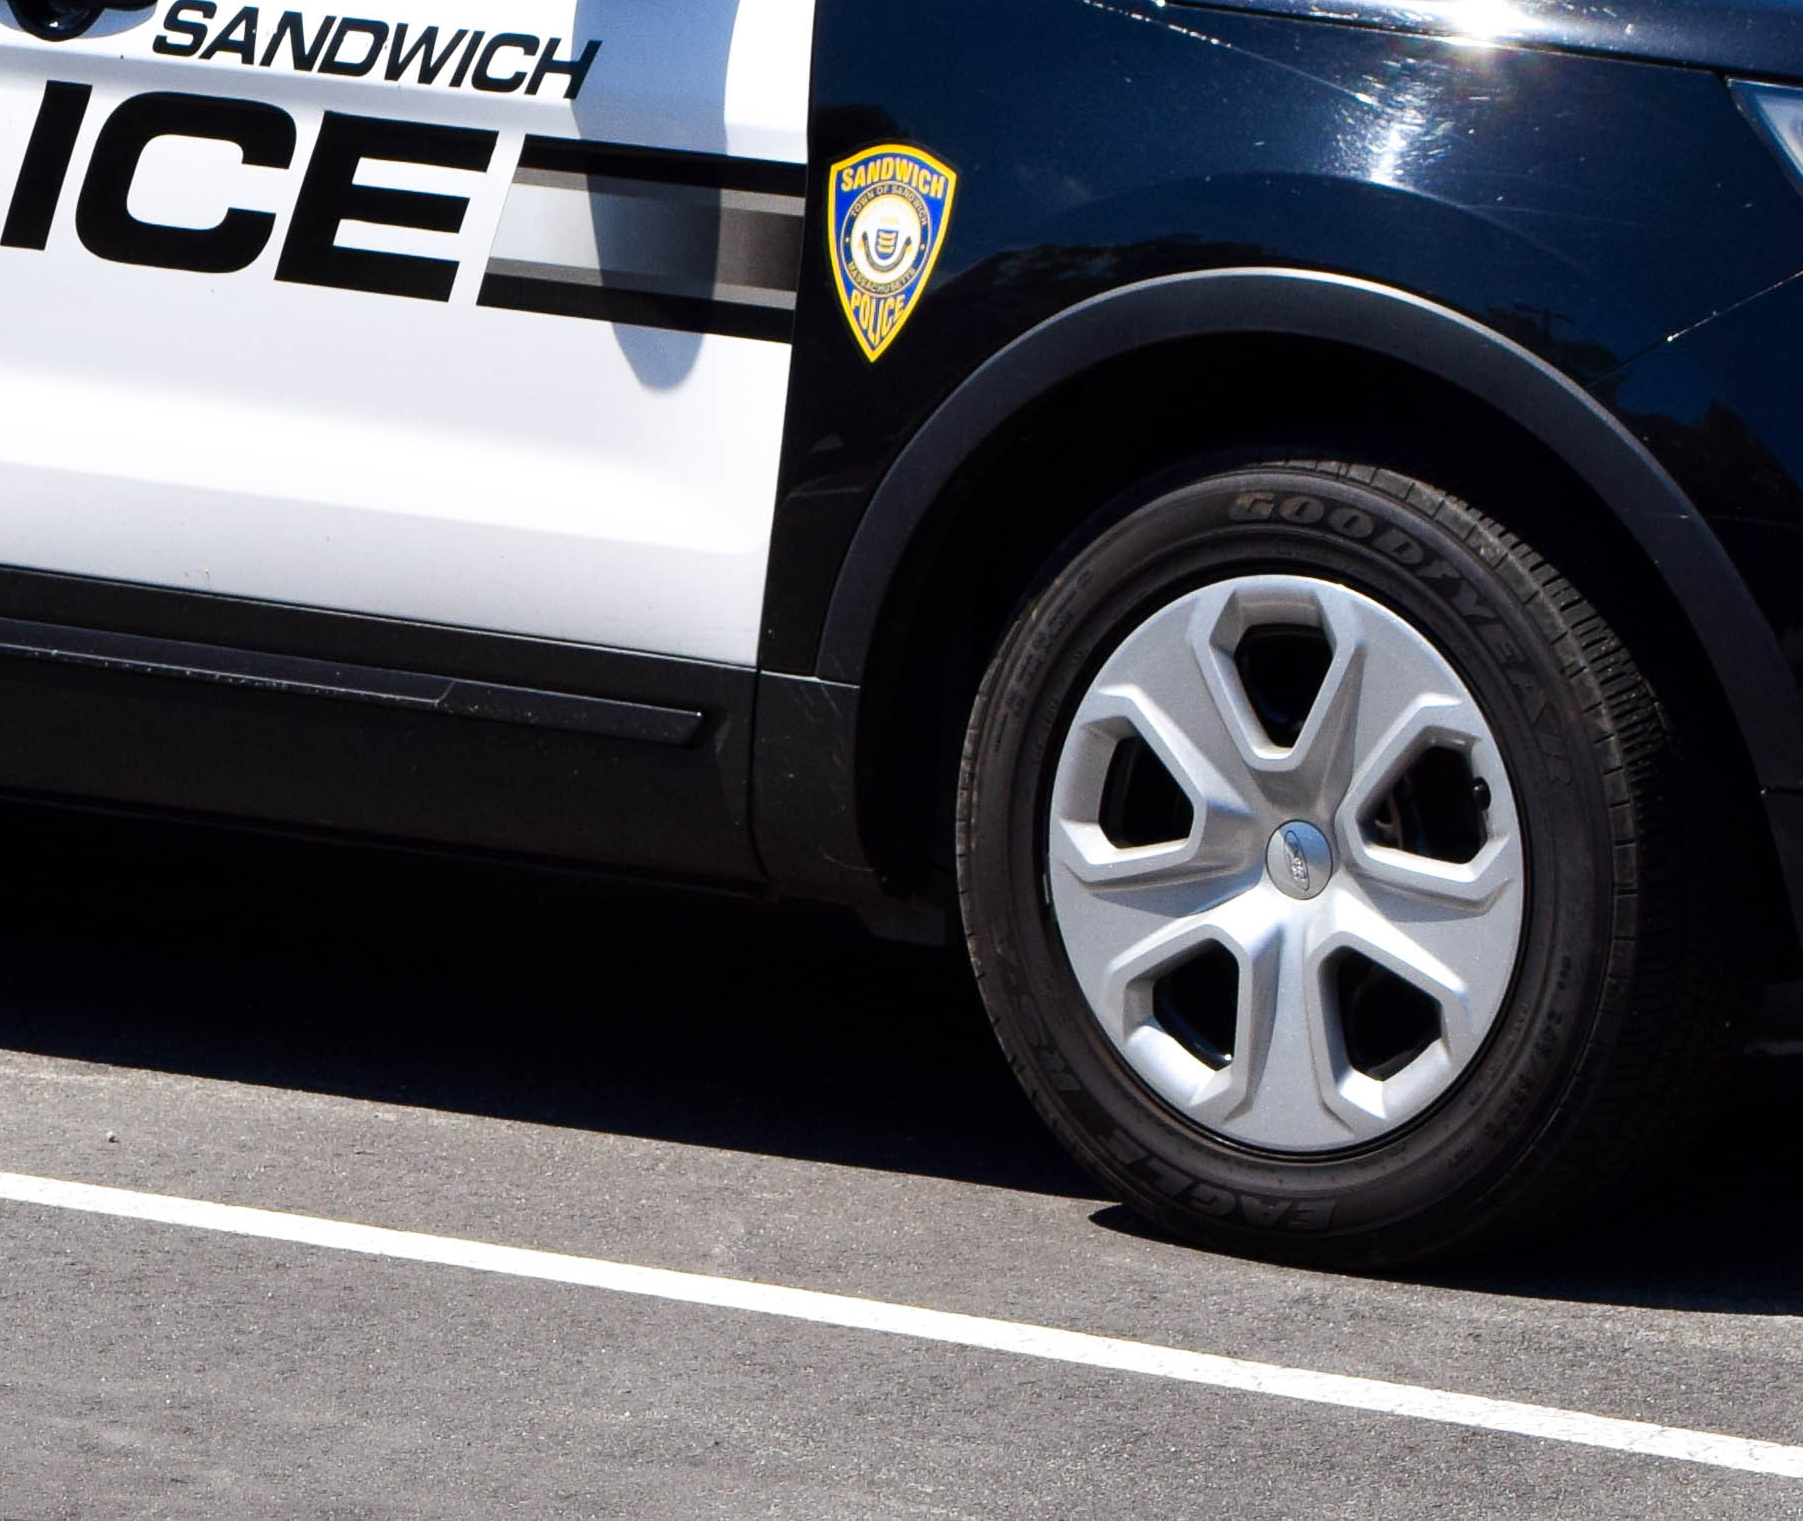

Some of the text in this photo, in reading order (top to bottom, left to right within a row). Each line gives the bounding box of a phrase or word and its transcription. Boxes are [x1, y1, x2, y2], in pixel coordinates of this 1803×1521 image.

[840, 157, 945, 199] SANDWICH
[851, 190, 876, 217] TOWN
[891, 184, 928, 226] SANDWICH
[850, 289, 905, 347] POLICE
[1229, 490, 1572, 787] GOODYEAR
